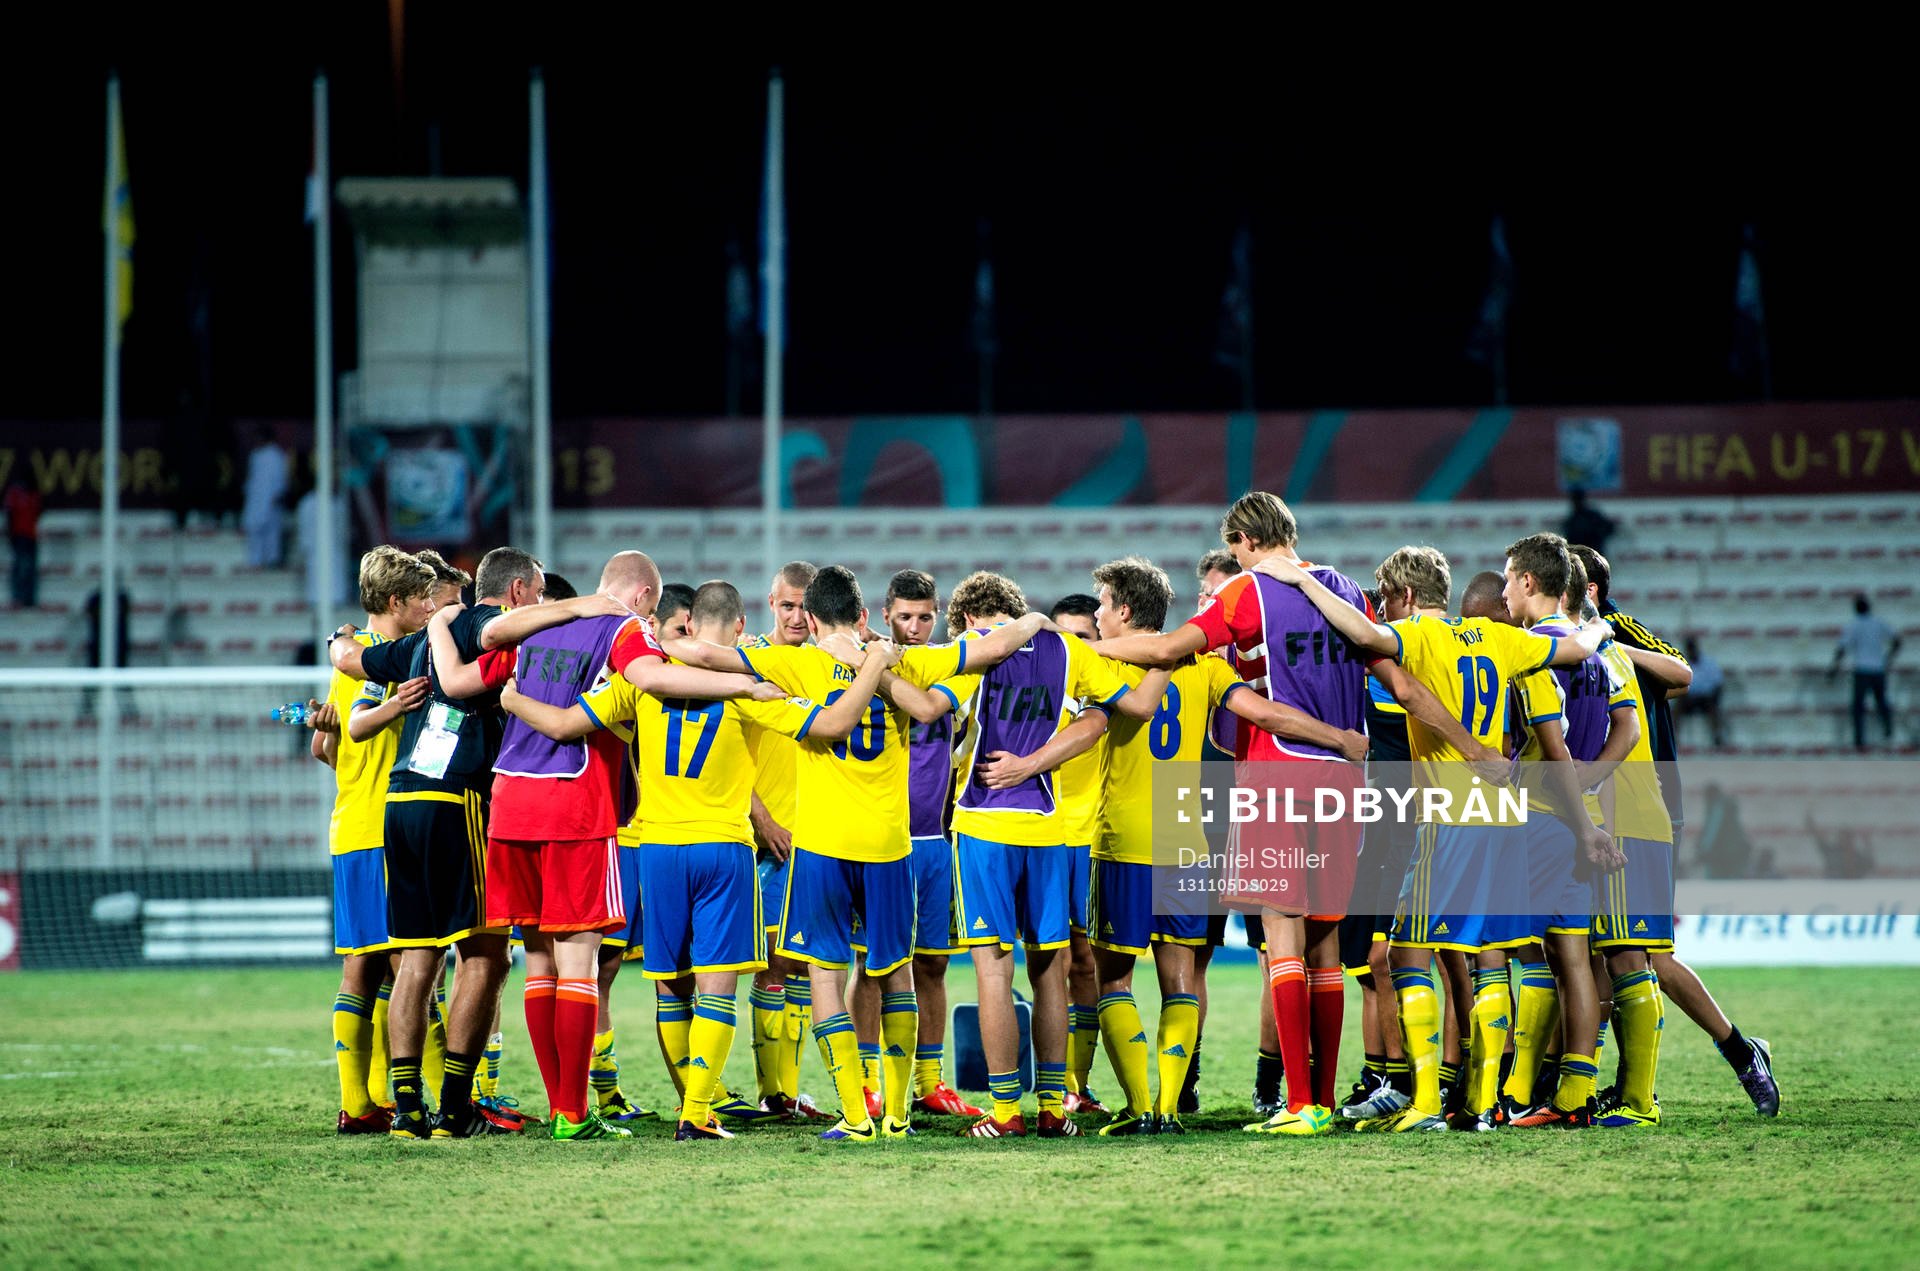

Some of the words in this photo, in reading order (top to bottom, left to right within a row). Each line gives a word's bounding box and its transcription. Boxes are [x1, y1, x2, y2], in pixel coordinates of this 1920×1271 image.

[1648, 433, 1756, 480] FIFA
[1770, 430, 1885, 480] U-17
[1148, 680, 1182, 761] 8
[1457, 655, 1499, 736] 19
[661, 698, 725, 779] 17
[1697, 902, 1788, 938] First
[1804, 901, 1902, 941] Gulf
